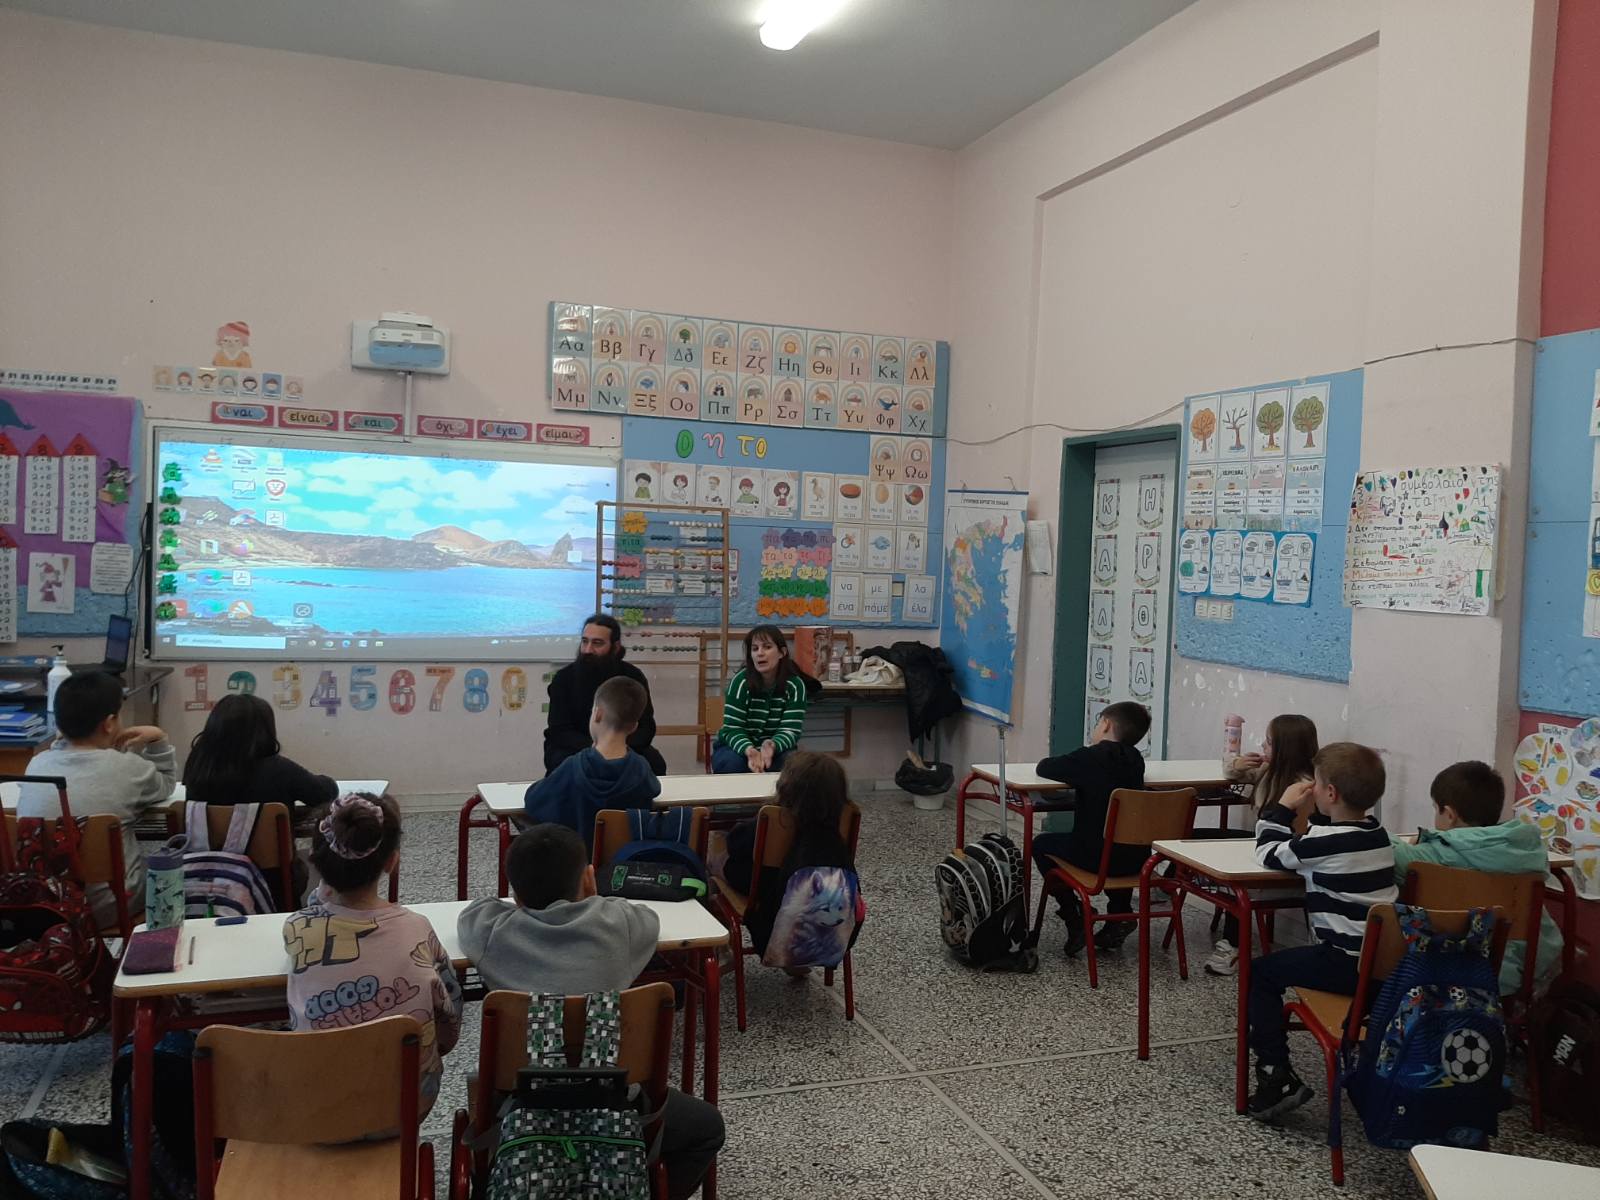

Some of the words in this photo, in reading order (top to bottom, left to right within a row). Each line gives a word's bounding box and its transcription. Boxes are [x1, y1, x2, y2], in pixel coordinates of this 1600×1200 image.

[349, 665, 378, 711] 5
[389, 669, 416, 715] 6
[424, 666, 455, 712] 7
[464, 668, 490, 713] 8
